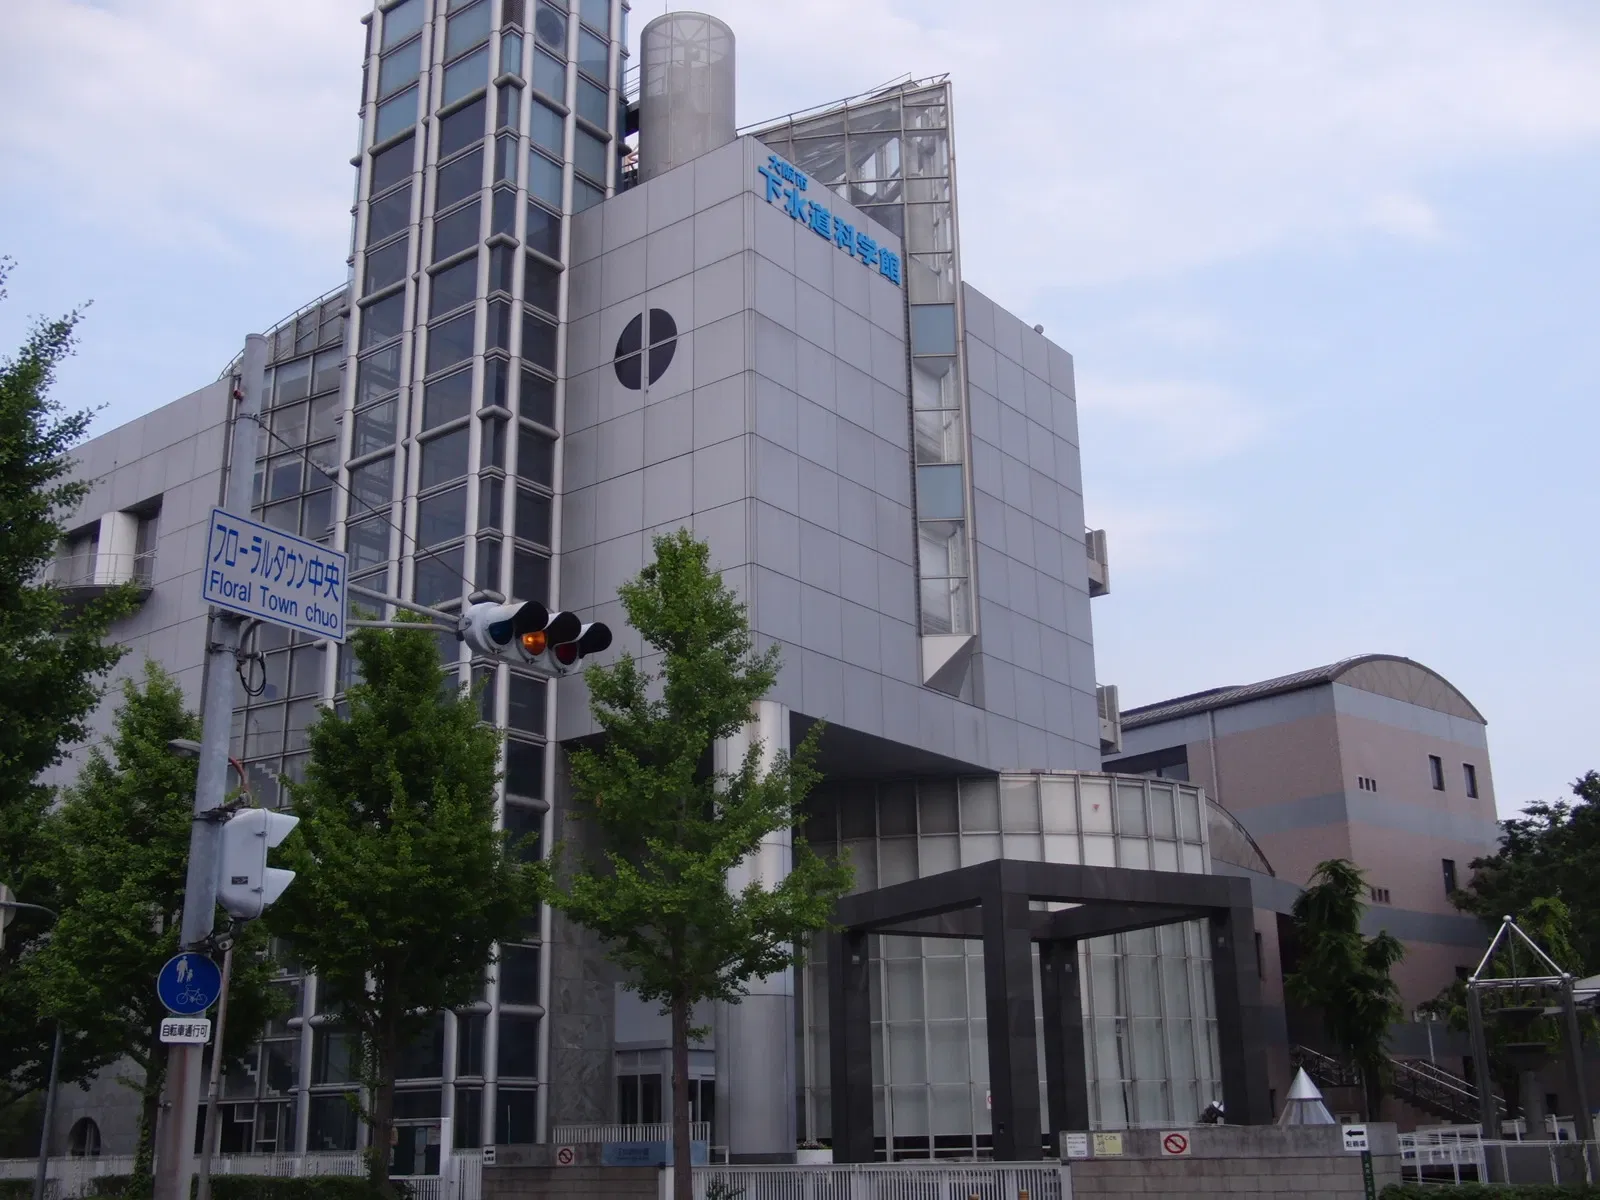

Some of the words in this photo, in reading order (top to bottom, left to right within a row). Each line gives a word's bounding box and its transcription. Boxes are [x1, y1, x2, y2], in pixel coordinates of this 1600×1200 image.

[768, 155, 808, 191] 大阪市
[758, 165, 901, 286] 下水道科学館
[213, 524, 339, 602] フローラルタウン中央
[210, 570, 251, 602] Floral
[260, 585, 298, 617] Town
[305, 602, 338, 629] chuo
[162, 1024, 208, 1037] 自転車通行可
